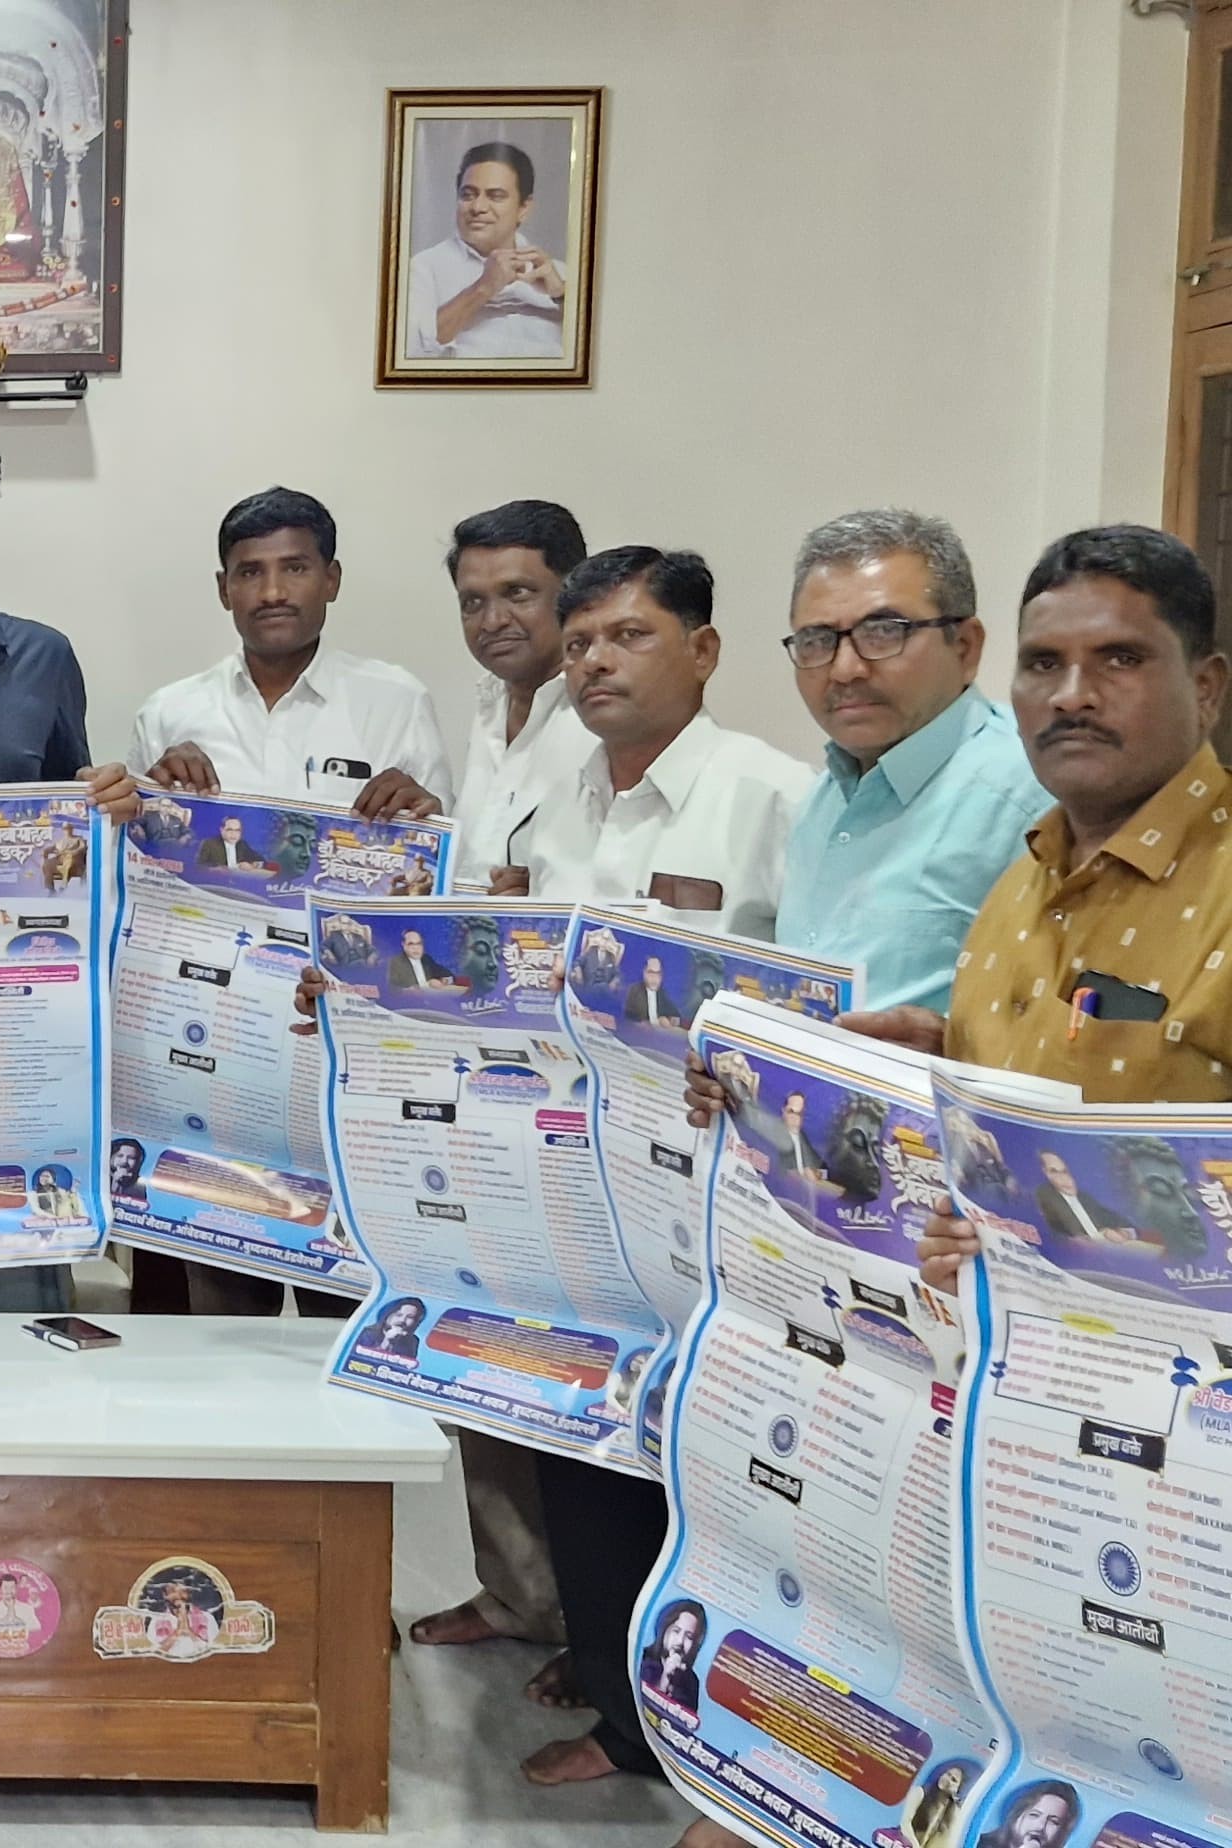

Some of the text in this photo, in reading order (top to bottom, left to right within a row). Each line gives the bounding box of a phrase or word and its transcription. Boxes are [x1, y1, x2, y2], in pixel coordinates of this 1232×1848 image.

[1200, 1412, 1231, 1431] (MLA
[1092, 1432, 1120, 1456] प्रमुख
[1085, 1608, 1114, 1632] मुख्य
